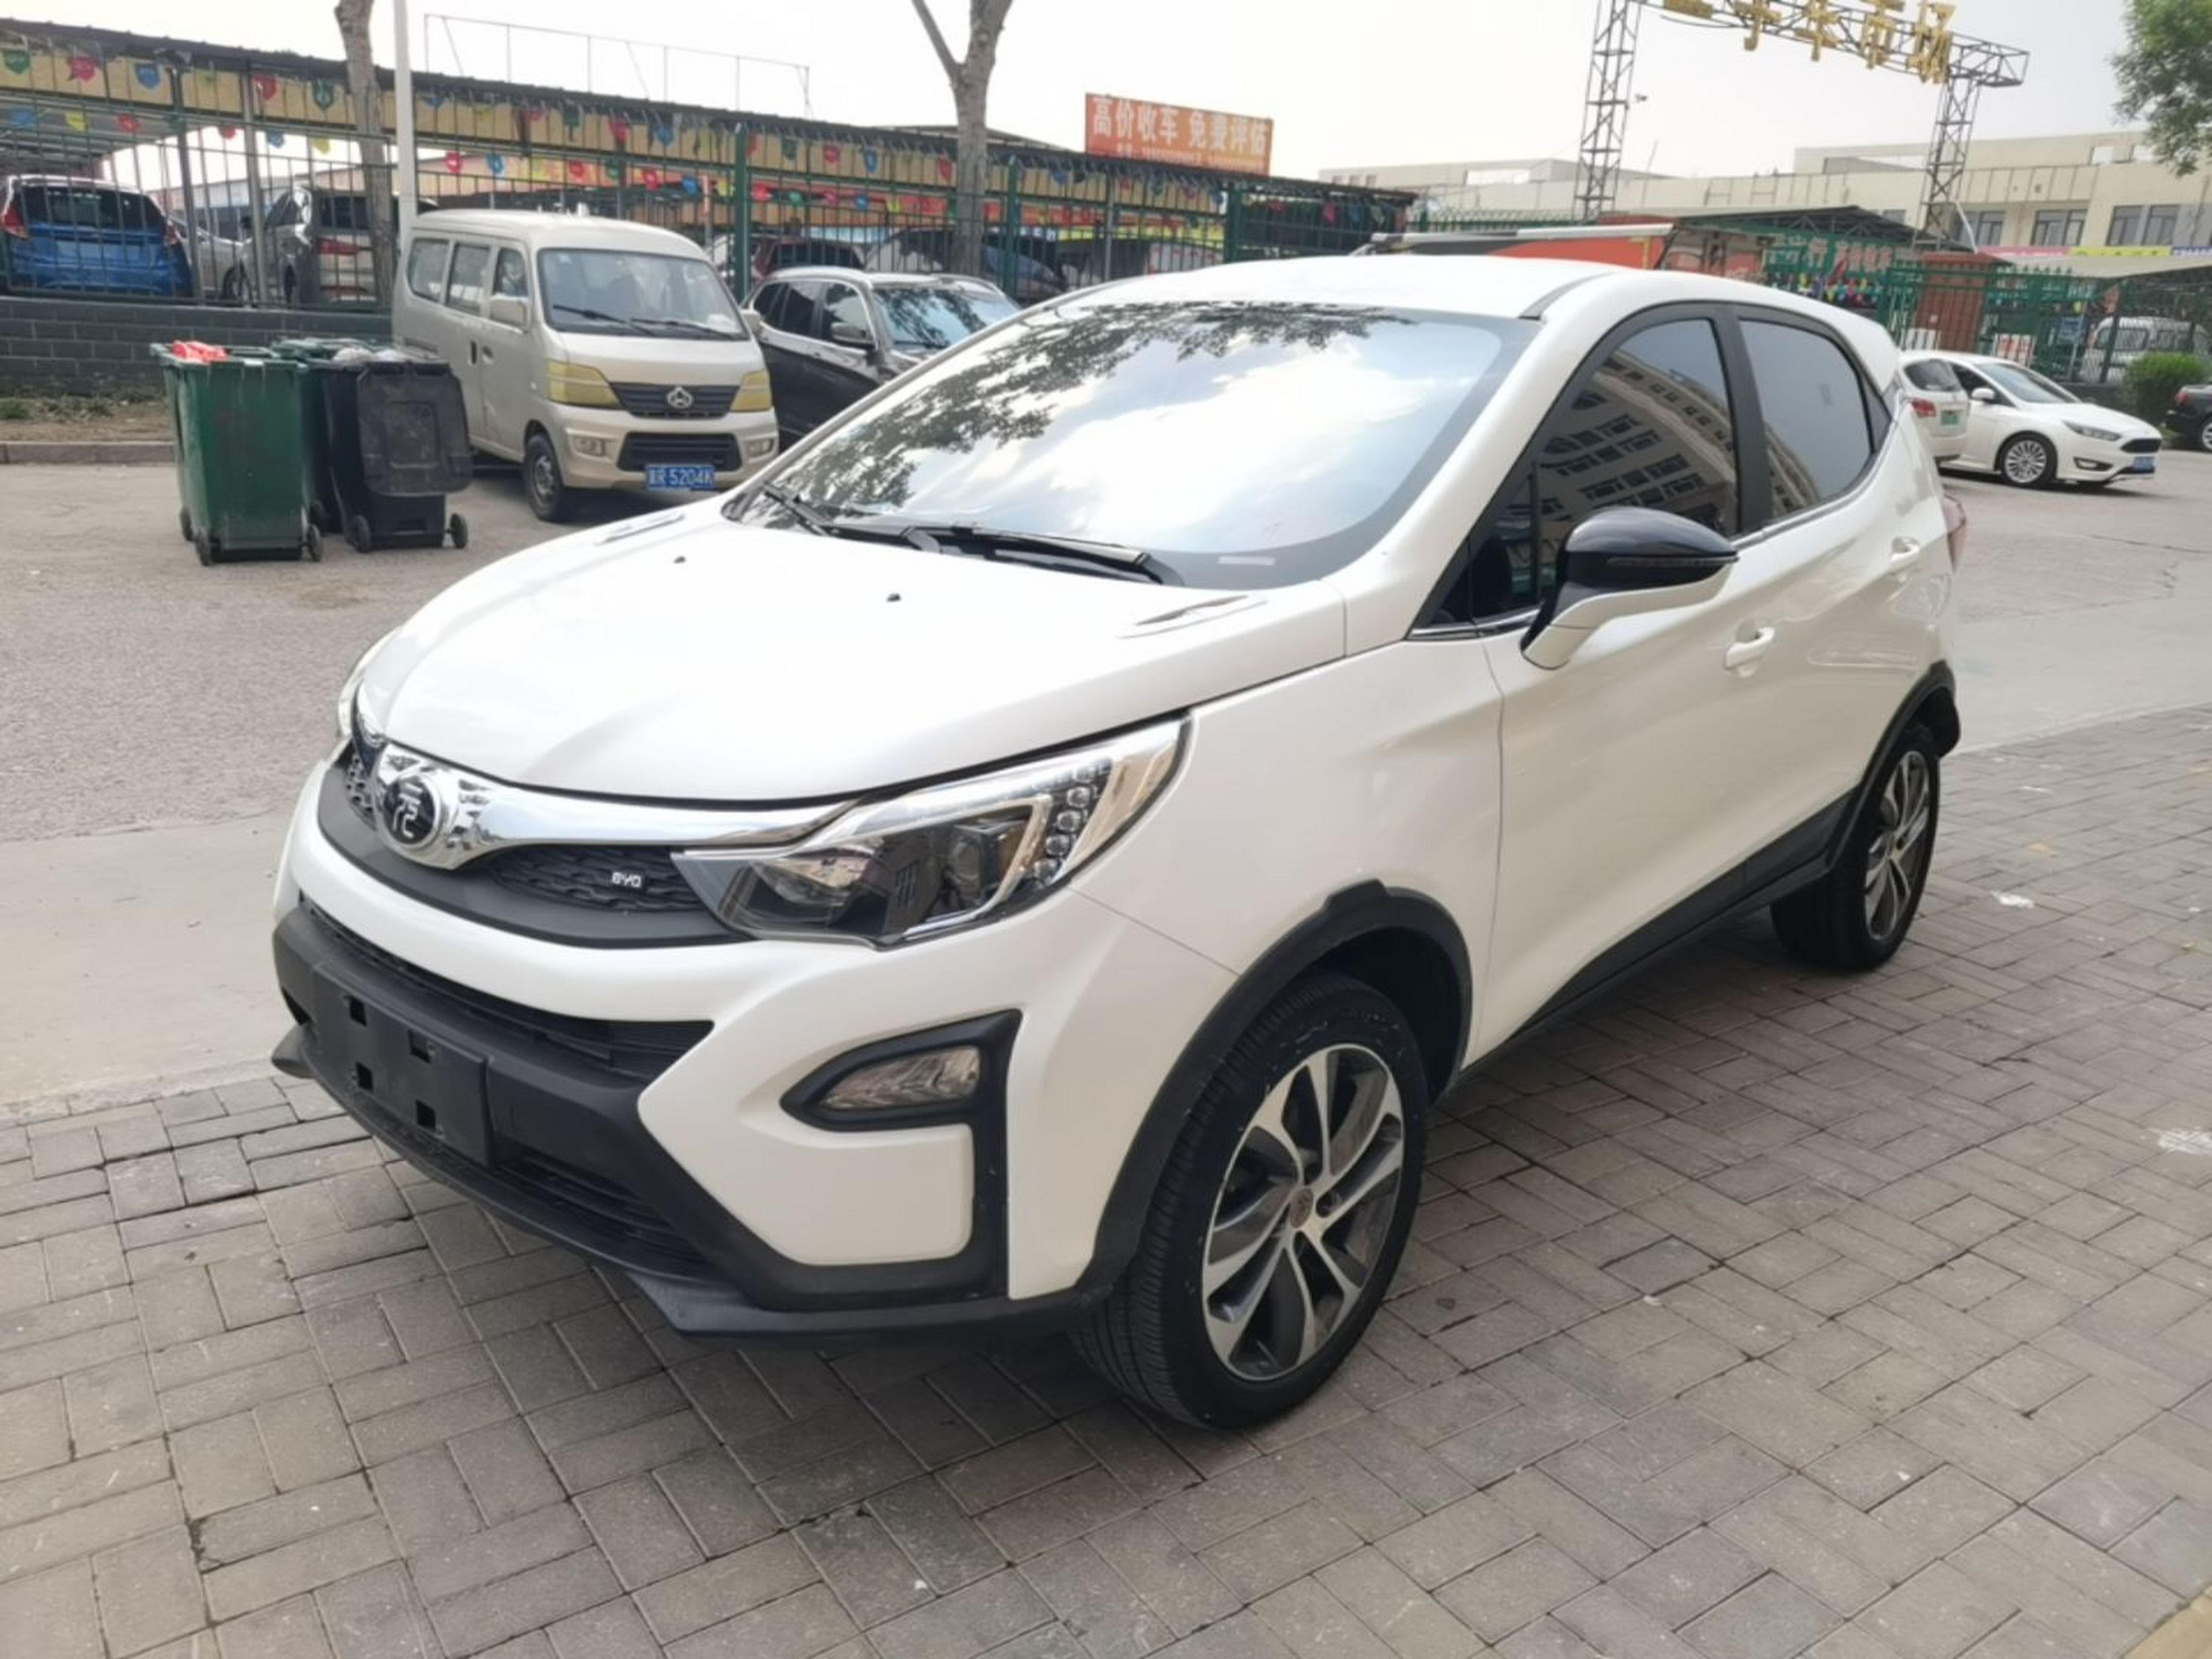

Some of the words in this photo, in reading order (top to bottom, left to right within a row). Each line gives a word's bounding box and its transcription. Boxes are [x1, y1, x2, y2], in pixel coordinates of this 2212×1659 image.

[1093, 97, 1179, 147] 高价收车
[612, 872, 641, 888] BYD
